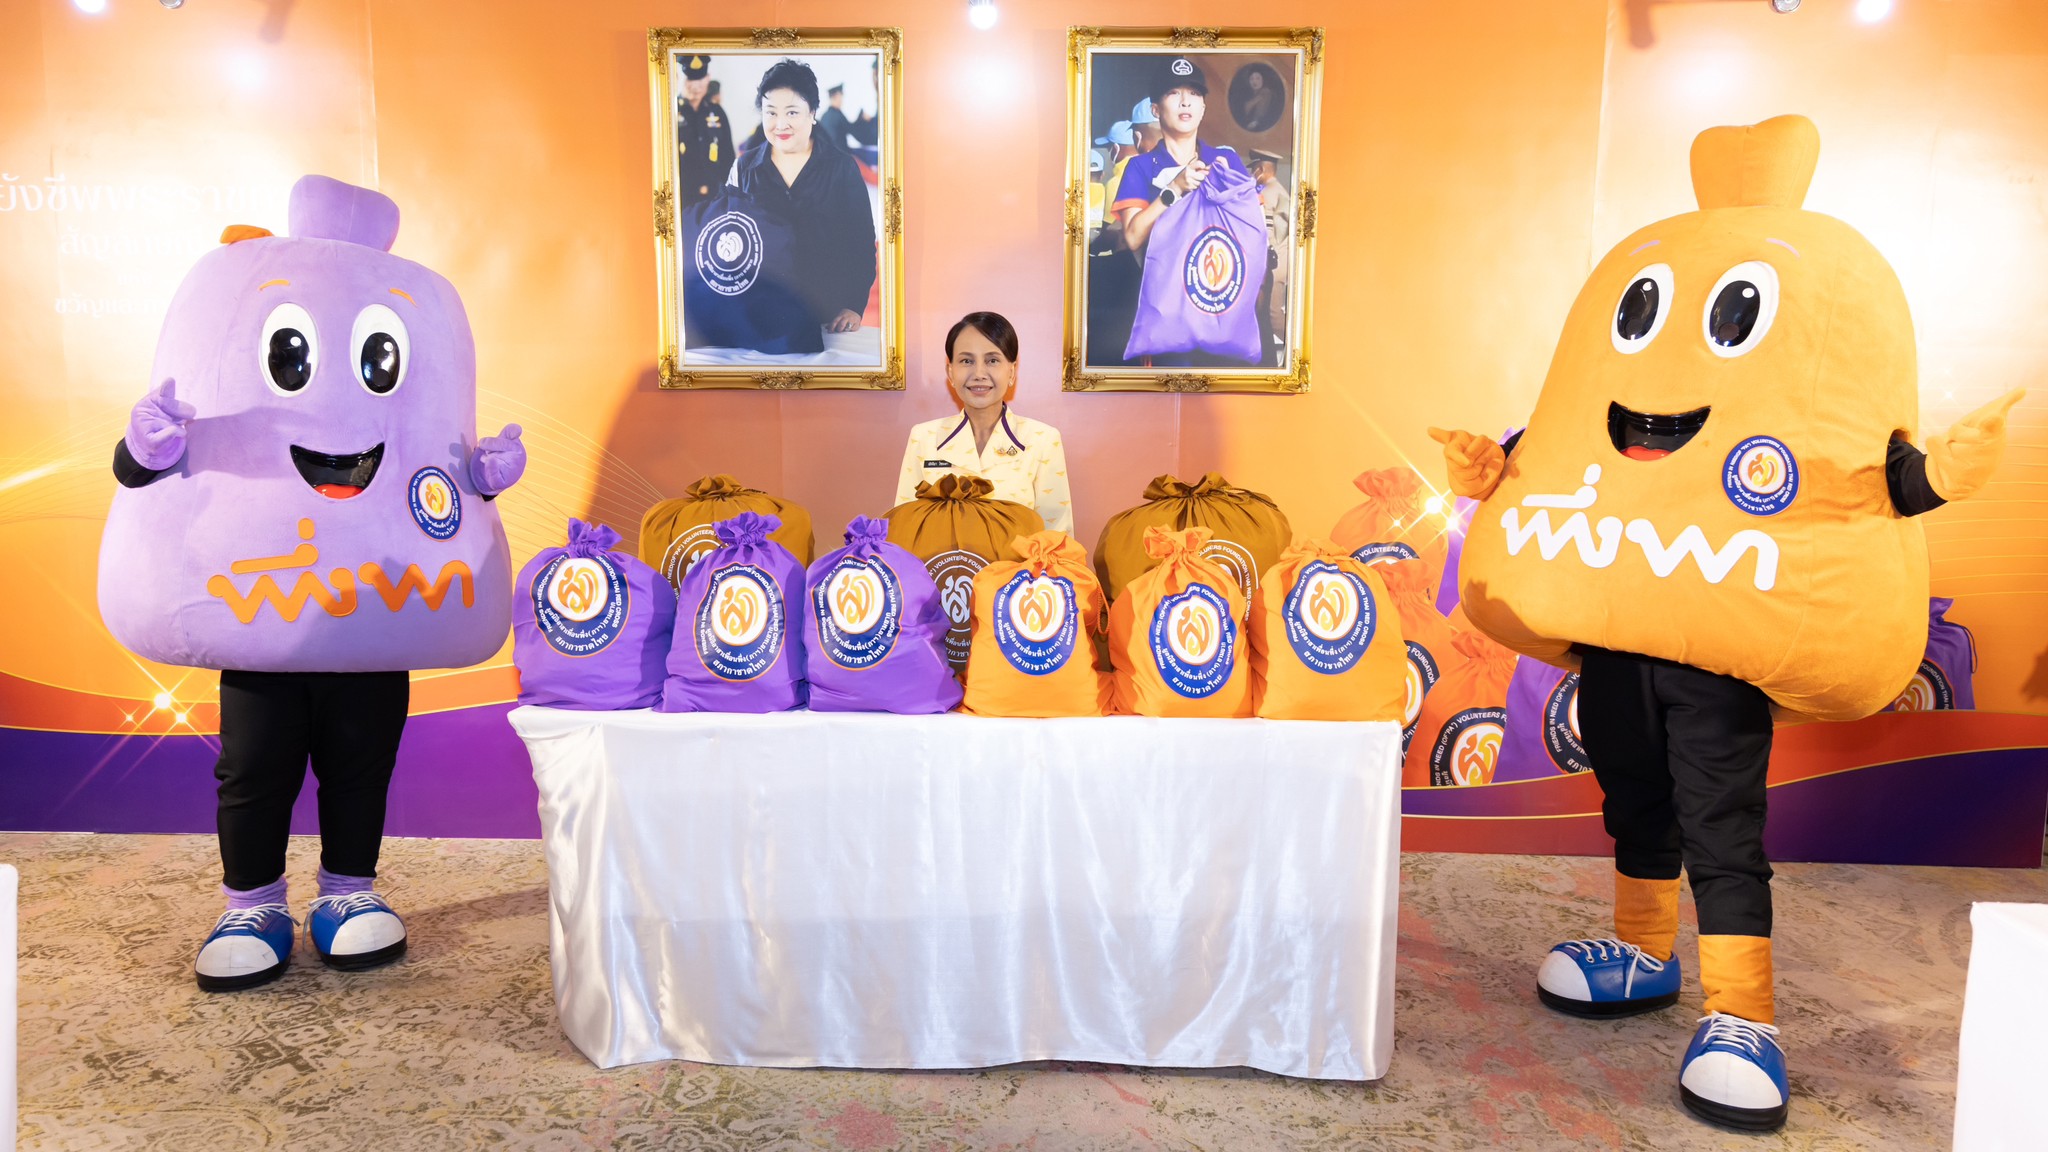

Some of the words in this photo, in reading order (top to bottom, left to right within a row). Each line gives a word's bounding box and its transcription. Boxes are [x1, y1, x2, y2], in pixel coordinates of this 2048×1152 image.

[1359, 546, 1399, 557] VOLUNTEERS
[868, 559, 892, 589] OUNDATION
[751, 569, 776, 604] FOUNDATION
[1201, 589, 1225, 617] FOUNDATION
[555, 633, 609, 652] สภากาชาดไทย
[1359, 626, 1369, 645] CROSS
[832, 645, 885, 664] สภากาชาดไทย
[1012, 652, 1063, 670] สภากาชาดไทย
[1304, 651, 1354, 670] สภากาชาดไทย
[713, 658, 766, 676] สภากาชาดไทย
[1411, 647, 1435, 684] FOUNDATION
[1172, 674, 1222, 694] สภากาชาดไทย
[1457, 712, 1500, 724] VOLUNTEERS
